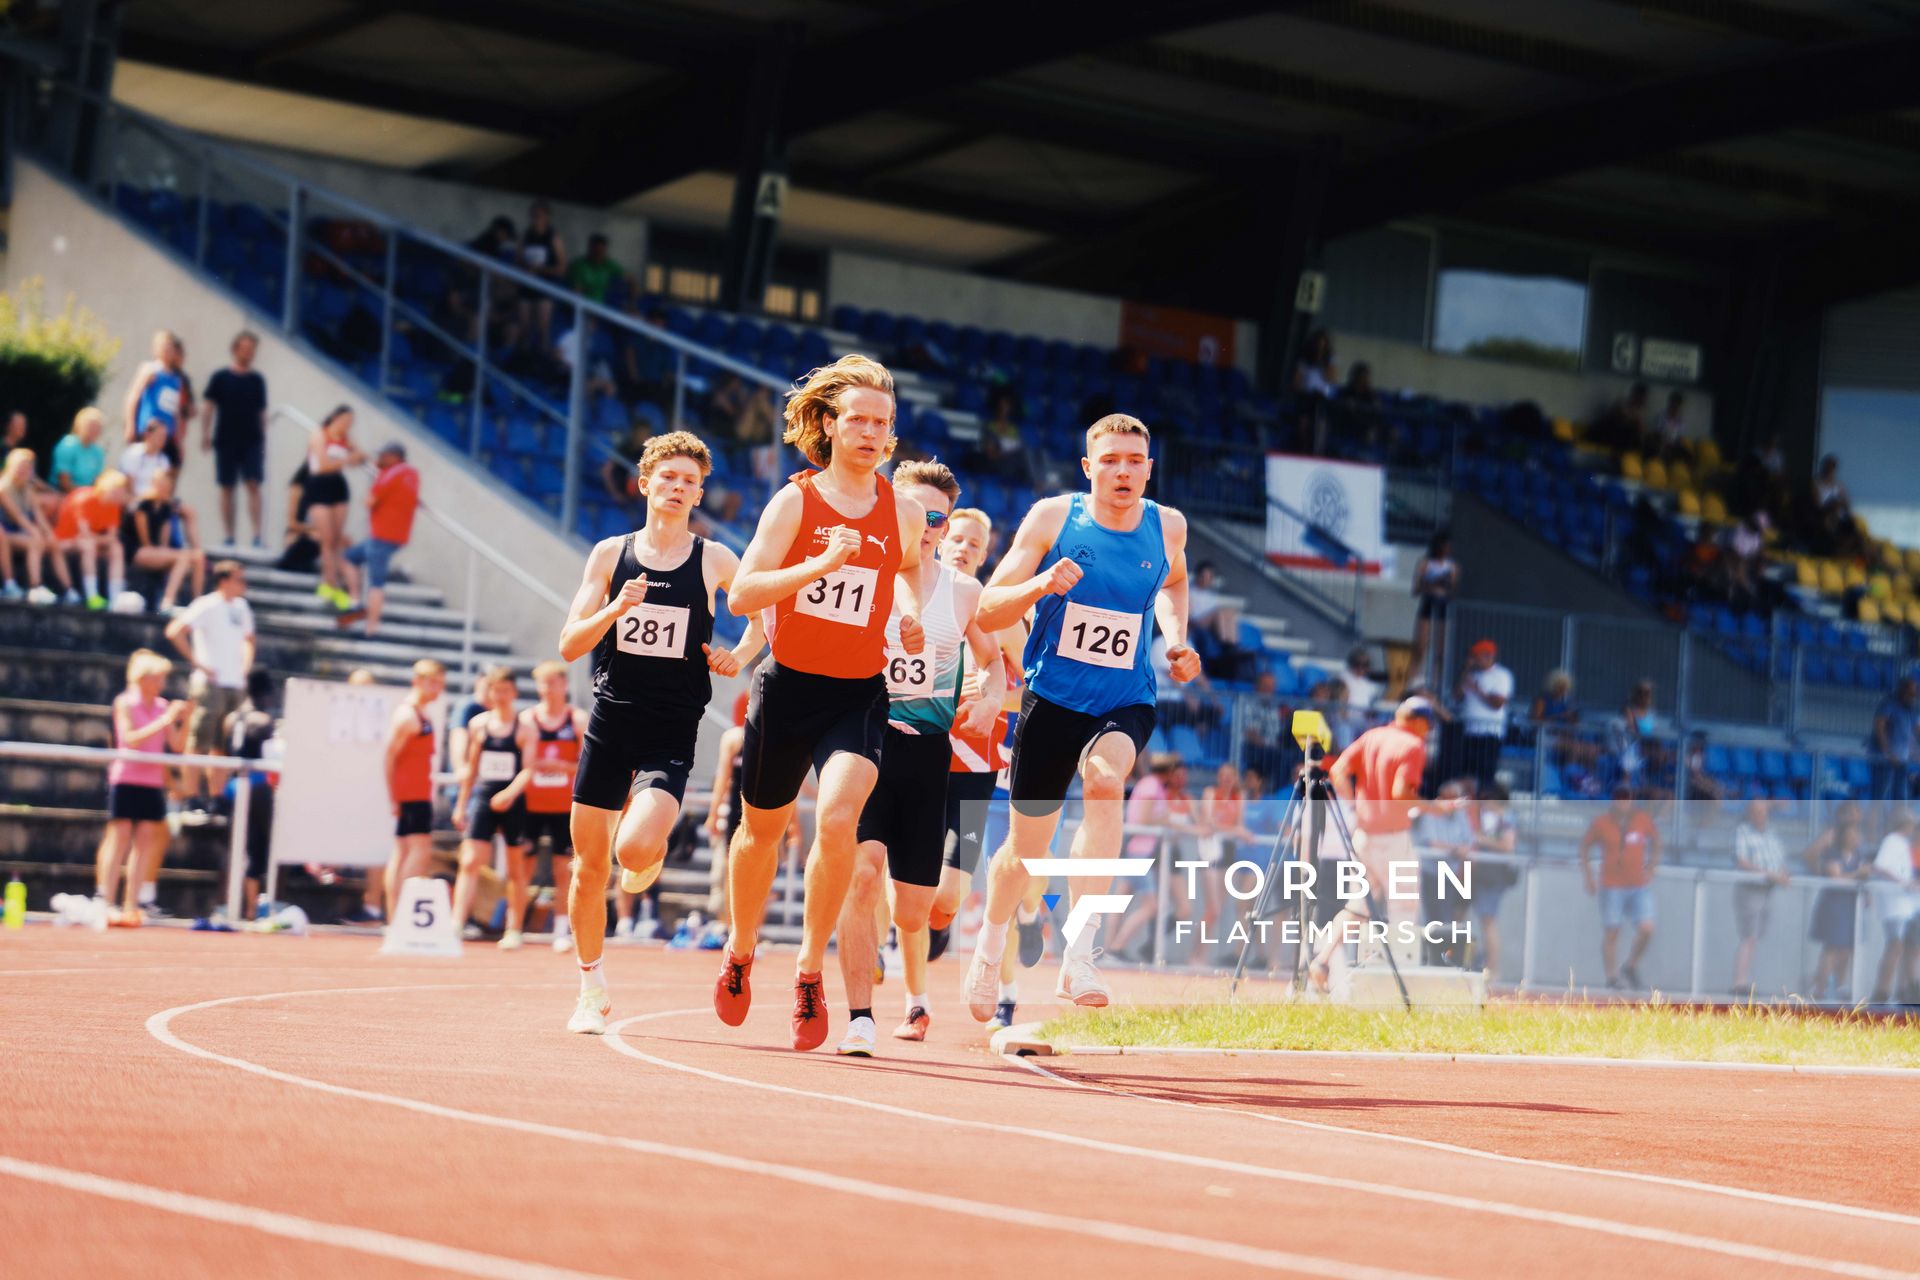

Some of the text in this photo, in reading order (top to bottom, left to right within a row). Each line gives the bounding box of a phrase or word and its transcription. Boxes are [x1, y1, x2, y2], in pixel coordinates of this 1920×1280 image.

[806, 576, 864, 612] 311
[623, 616, 676, 648] 281
[1072, 621, 1131, 657] 126
[889, 657, 926, 685] 63
[413, 899, 435, 928] 5
